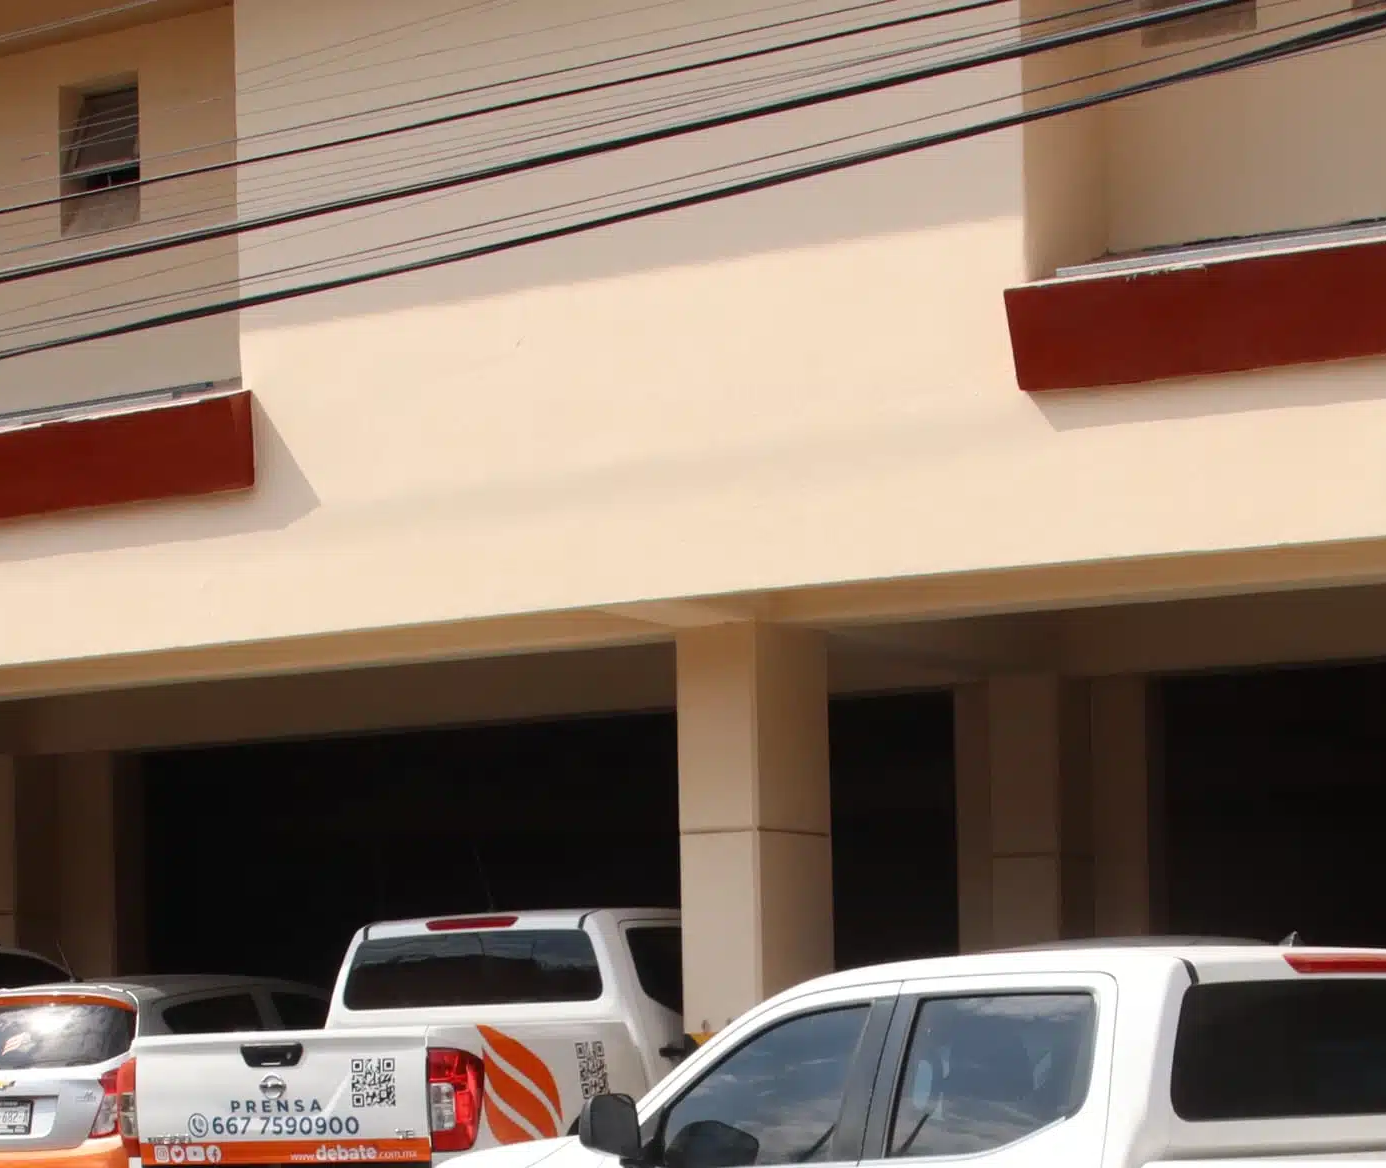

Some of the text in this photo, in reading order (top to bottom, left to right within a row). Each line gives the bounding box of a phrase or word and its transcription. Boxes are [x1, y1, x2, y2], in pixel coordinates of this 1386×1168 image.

[230, 1099, 322, 1113] PRENSA
[212, 1116, 359, 1135] 667 7590900
[290, 1145, 417, 1161] www.debate.com.mx
